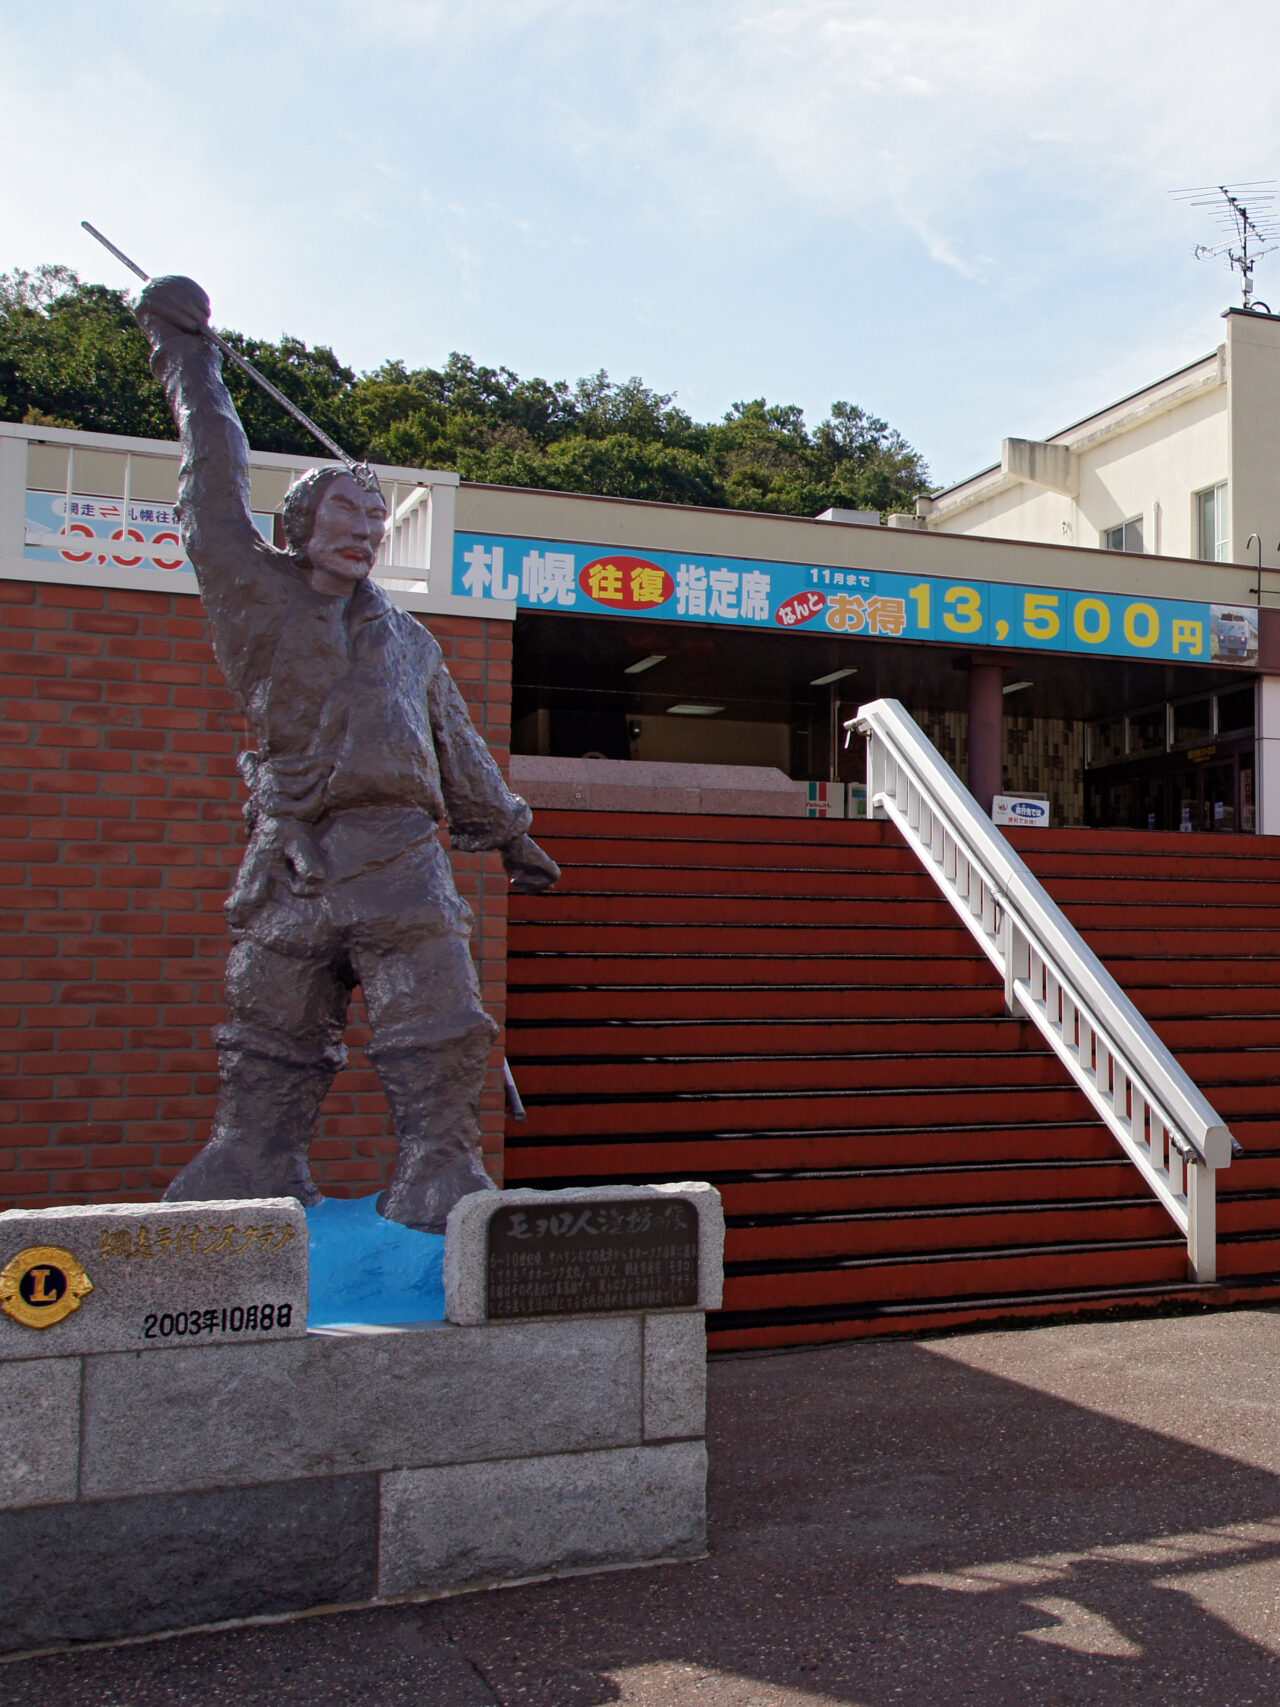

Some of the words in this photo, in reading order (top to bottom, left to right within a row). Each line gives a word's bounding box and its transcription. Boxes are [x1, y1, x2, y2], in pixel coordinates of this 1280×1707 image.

[462, 544, 576, 605] 札幌
[588, 564, 665, 604] 往復
[676, 564, 771, 621] 指定席
[810, 568, 871, 588] 11月まで
[778, 591, 823, 626] なんと
[826, 593, 906, 635] お得
[908, 583, 1203, 655] 13,500円
[30, 1270, 57, 1302] L
[144, 1303, 293, 1339] 2003年10月8日
